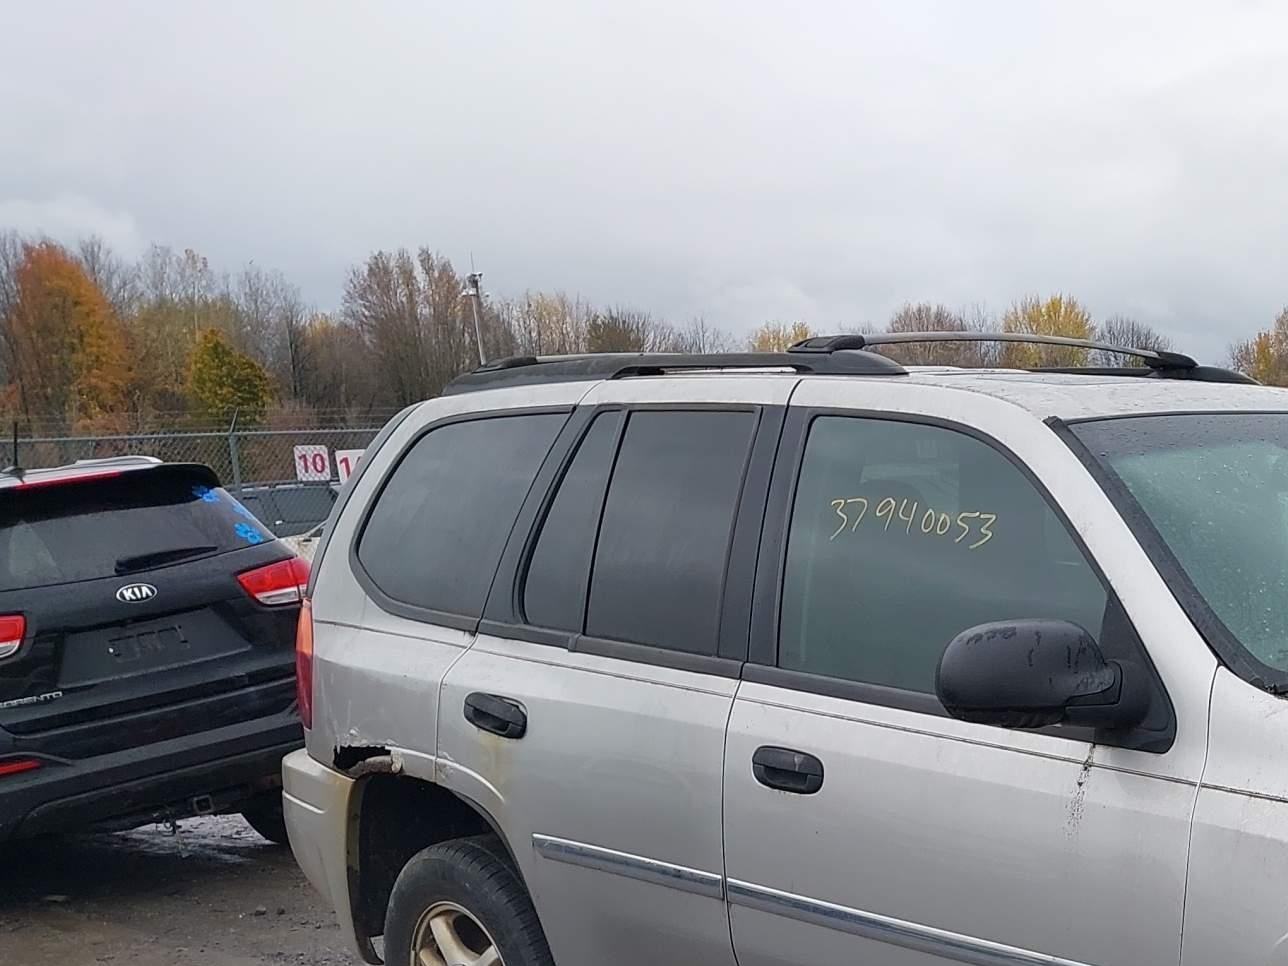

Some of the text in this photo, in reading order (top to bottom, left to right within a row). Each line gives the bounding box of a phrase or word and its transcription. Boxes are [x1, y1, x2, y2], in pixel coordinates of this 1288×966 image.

[298, 453, 326, 474] 10
[339, 456, 361, 480] 1
[829, 497, 998, 550] 37940053
[122, 585, 153, 601] KIA
[0, 690, 63, 709] ORENTO
